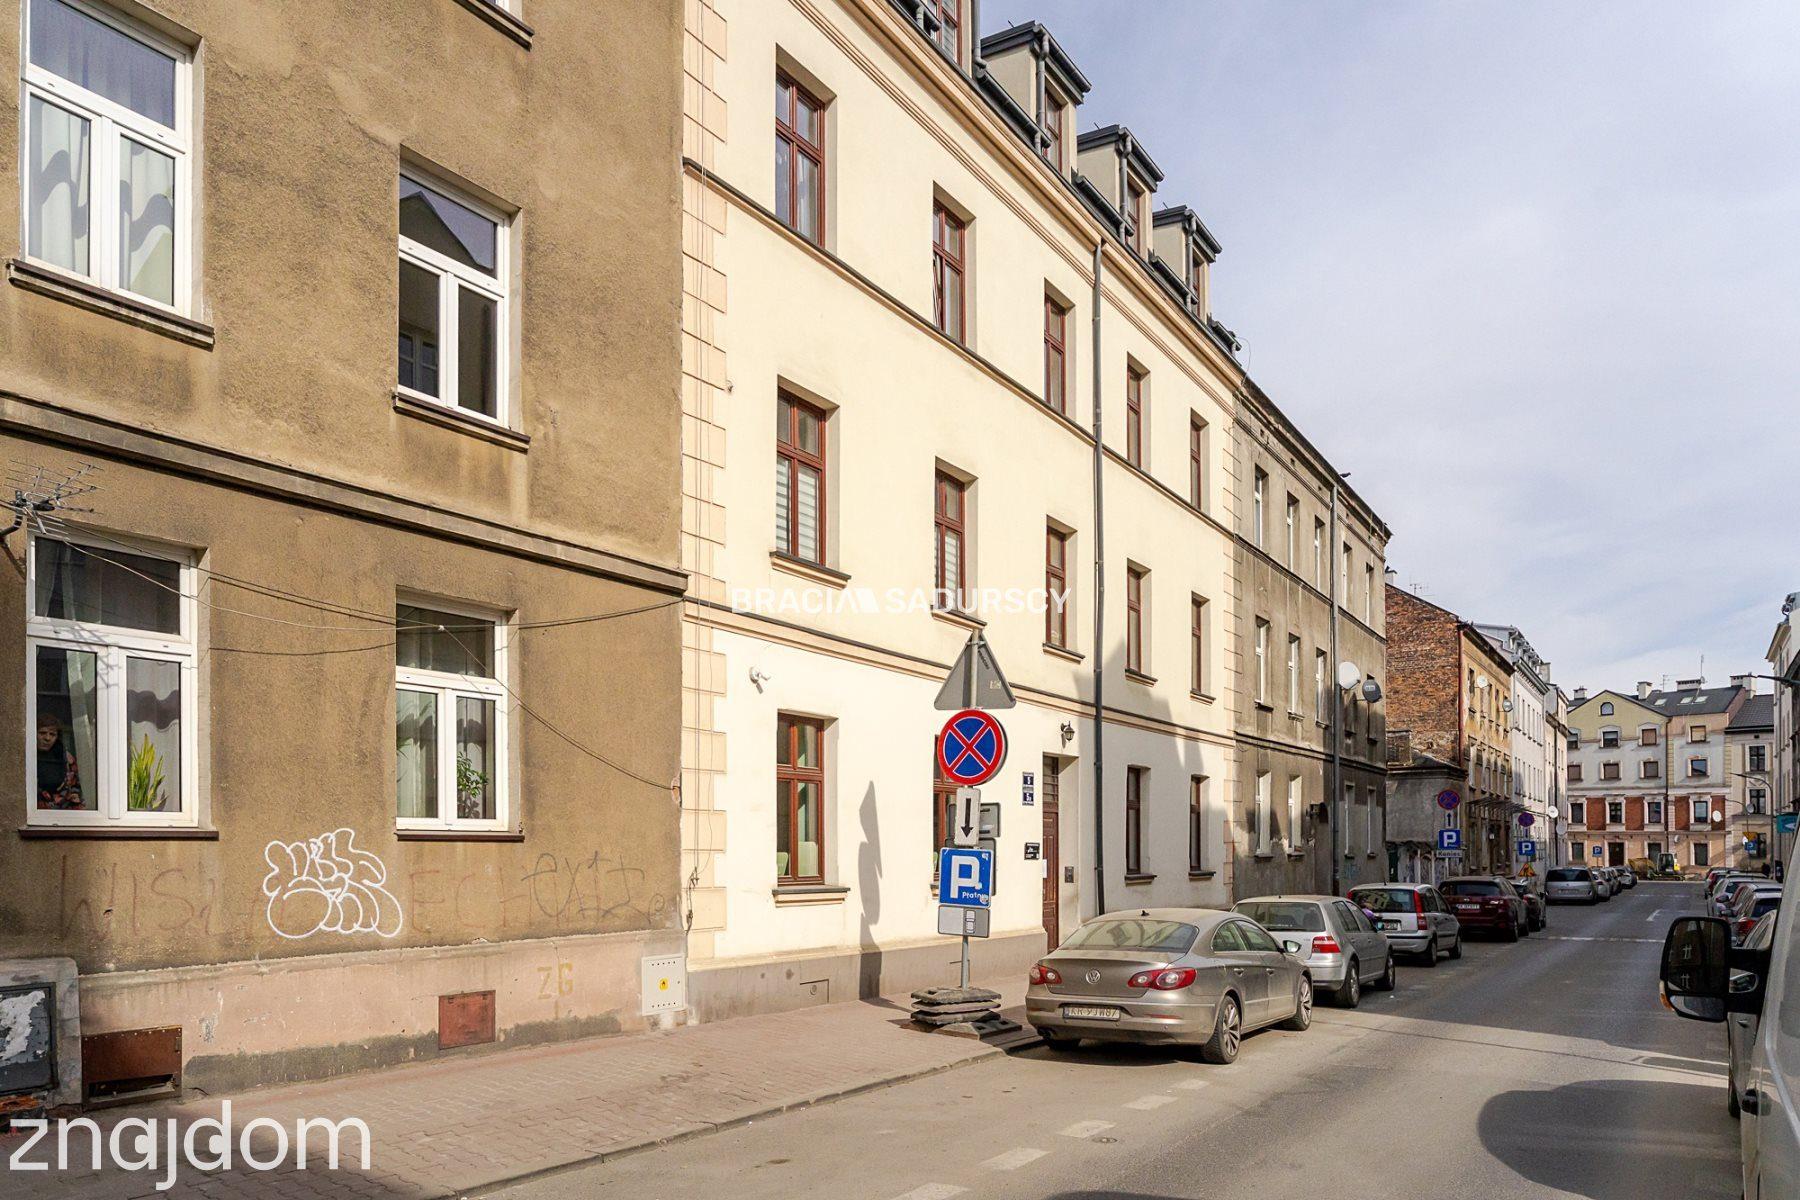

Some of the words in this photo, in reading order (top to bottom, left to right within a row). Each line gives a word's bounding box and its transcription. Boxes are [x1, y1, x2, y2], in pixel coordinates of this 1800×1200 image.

[1443, 832, 1457, 847] P
[1522, 842, 1532, 854] P
[950, 855, 980, 899] P
